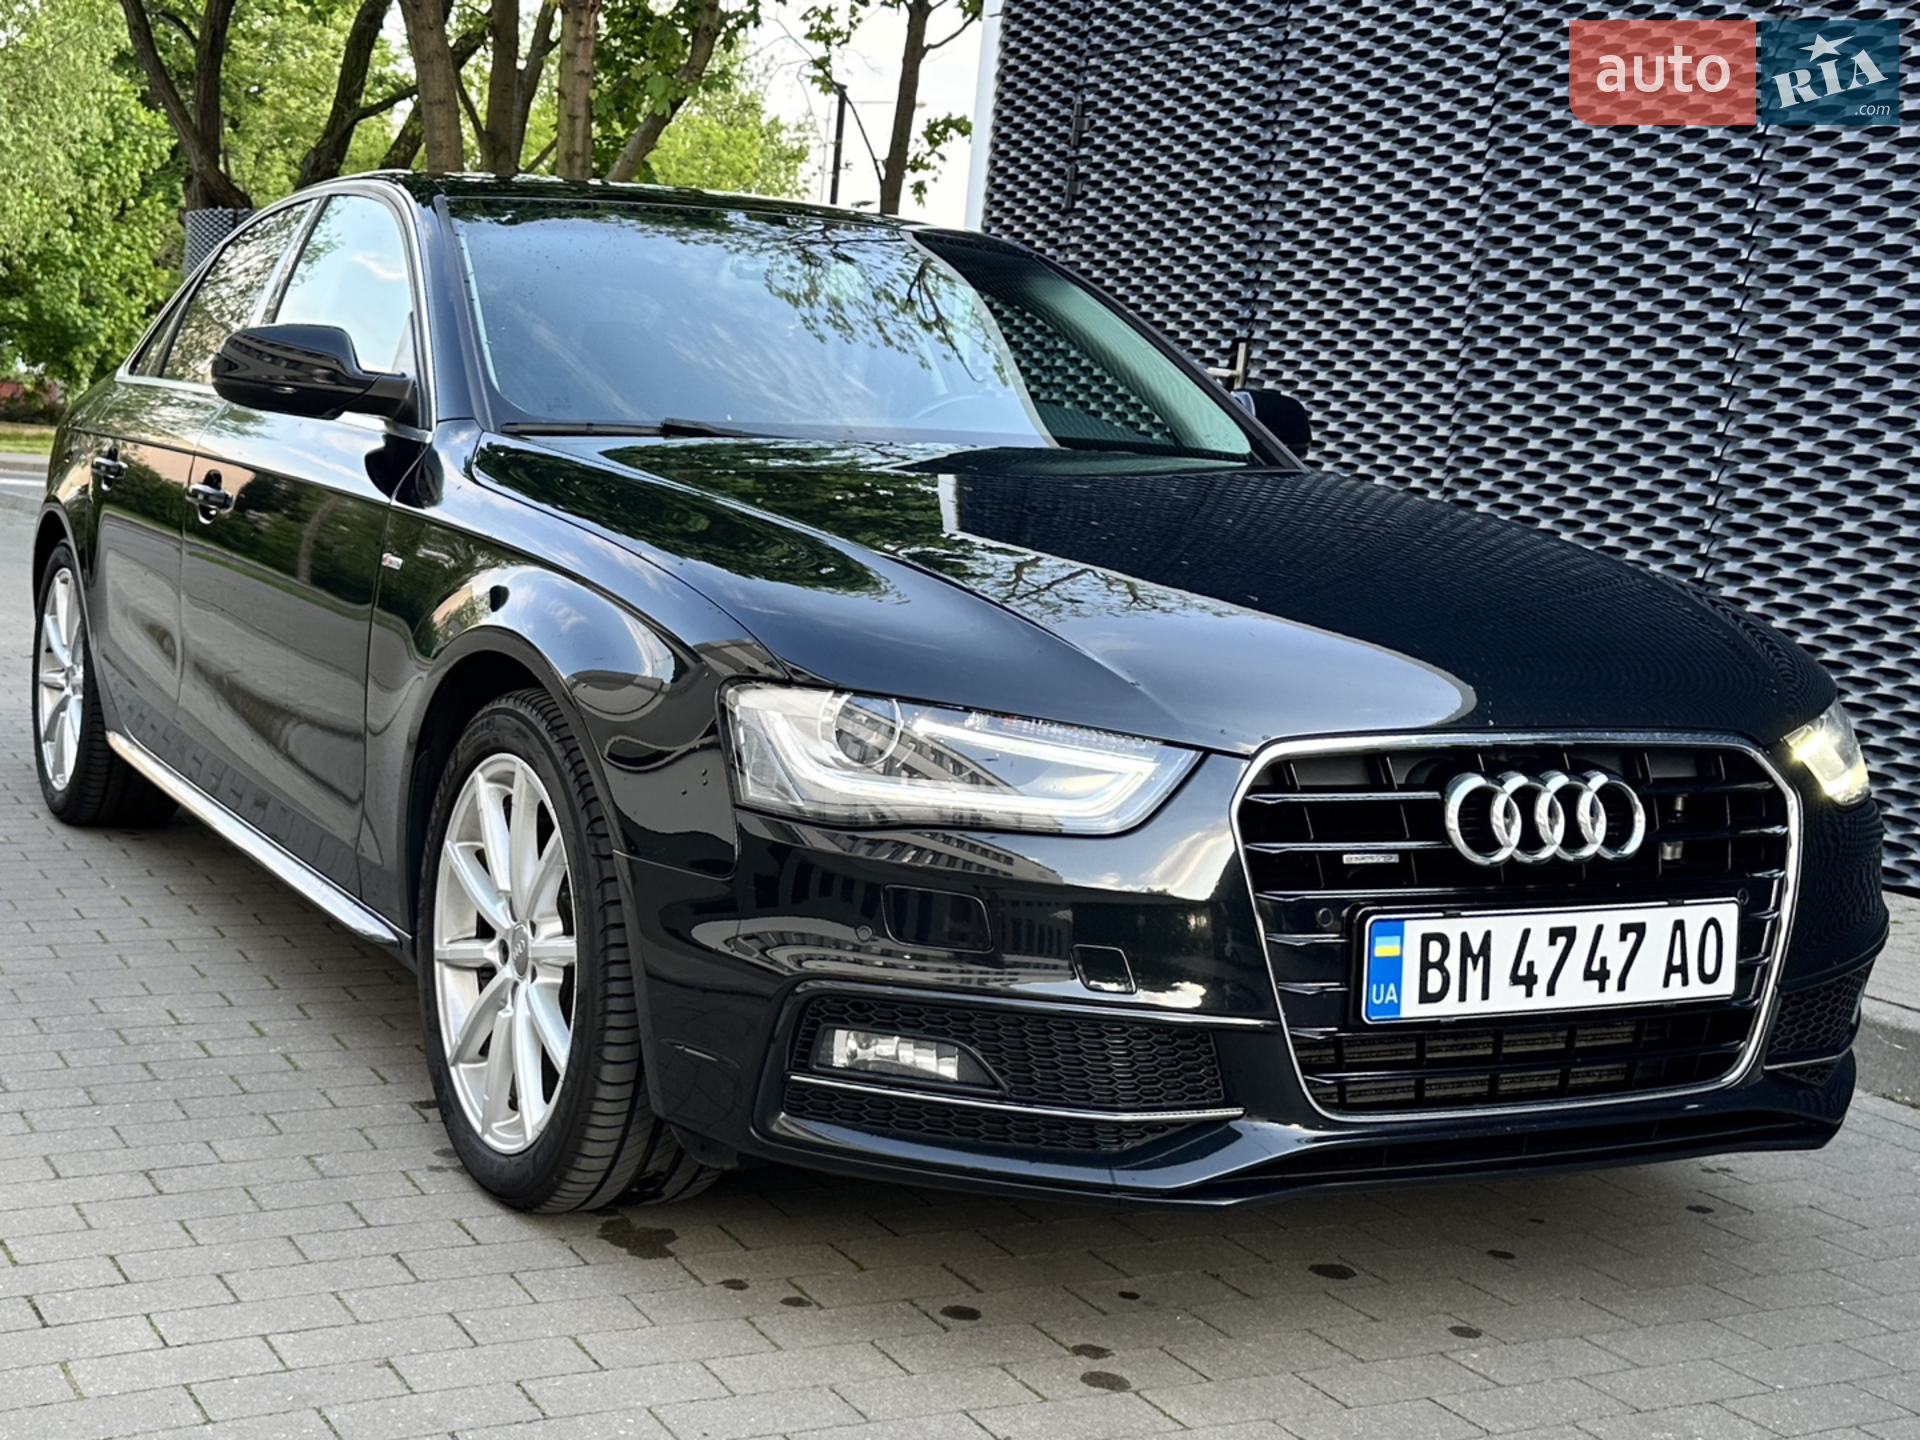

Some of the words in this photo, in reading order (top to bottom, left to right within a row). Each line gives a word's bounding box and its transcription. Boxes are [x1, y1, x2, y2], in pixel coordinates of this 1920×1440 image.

[1418, 930, 1492, 1004] BM
[1509, 922, 1647, 998] 4747
[1662, 917, 1724, 988] AO
[1372, 983, 1398, 1004] UA
